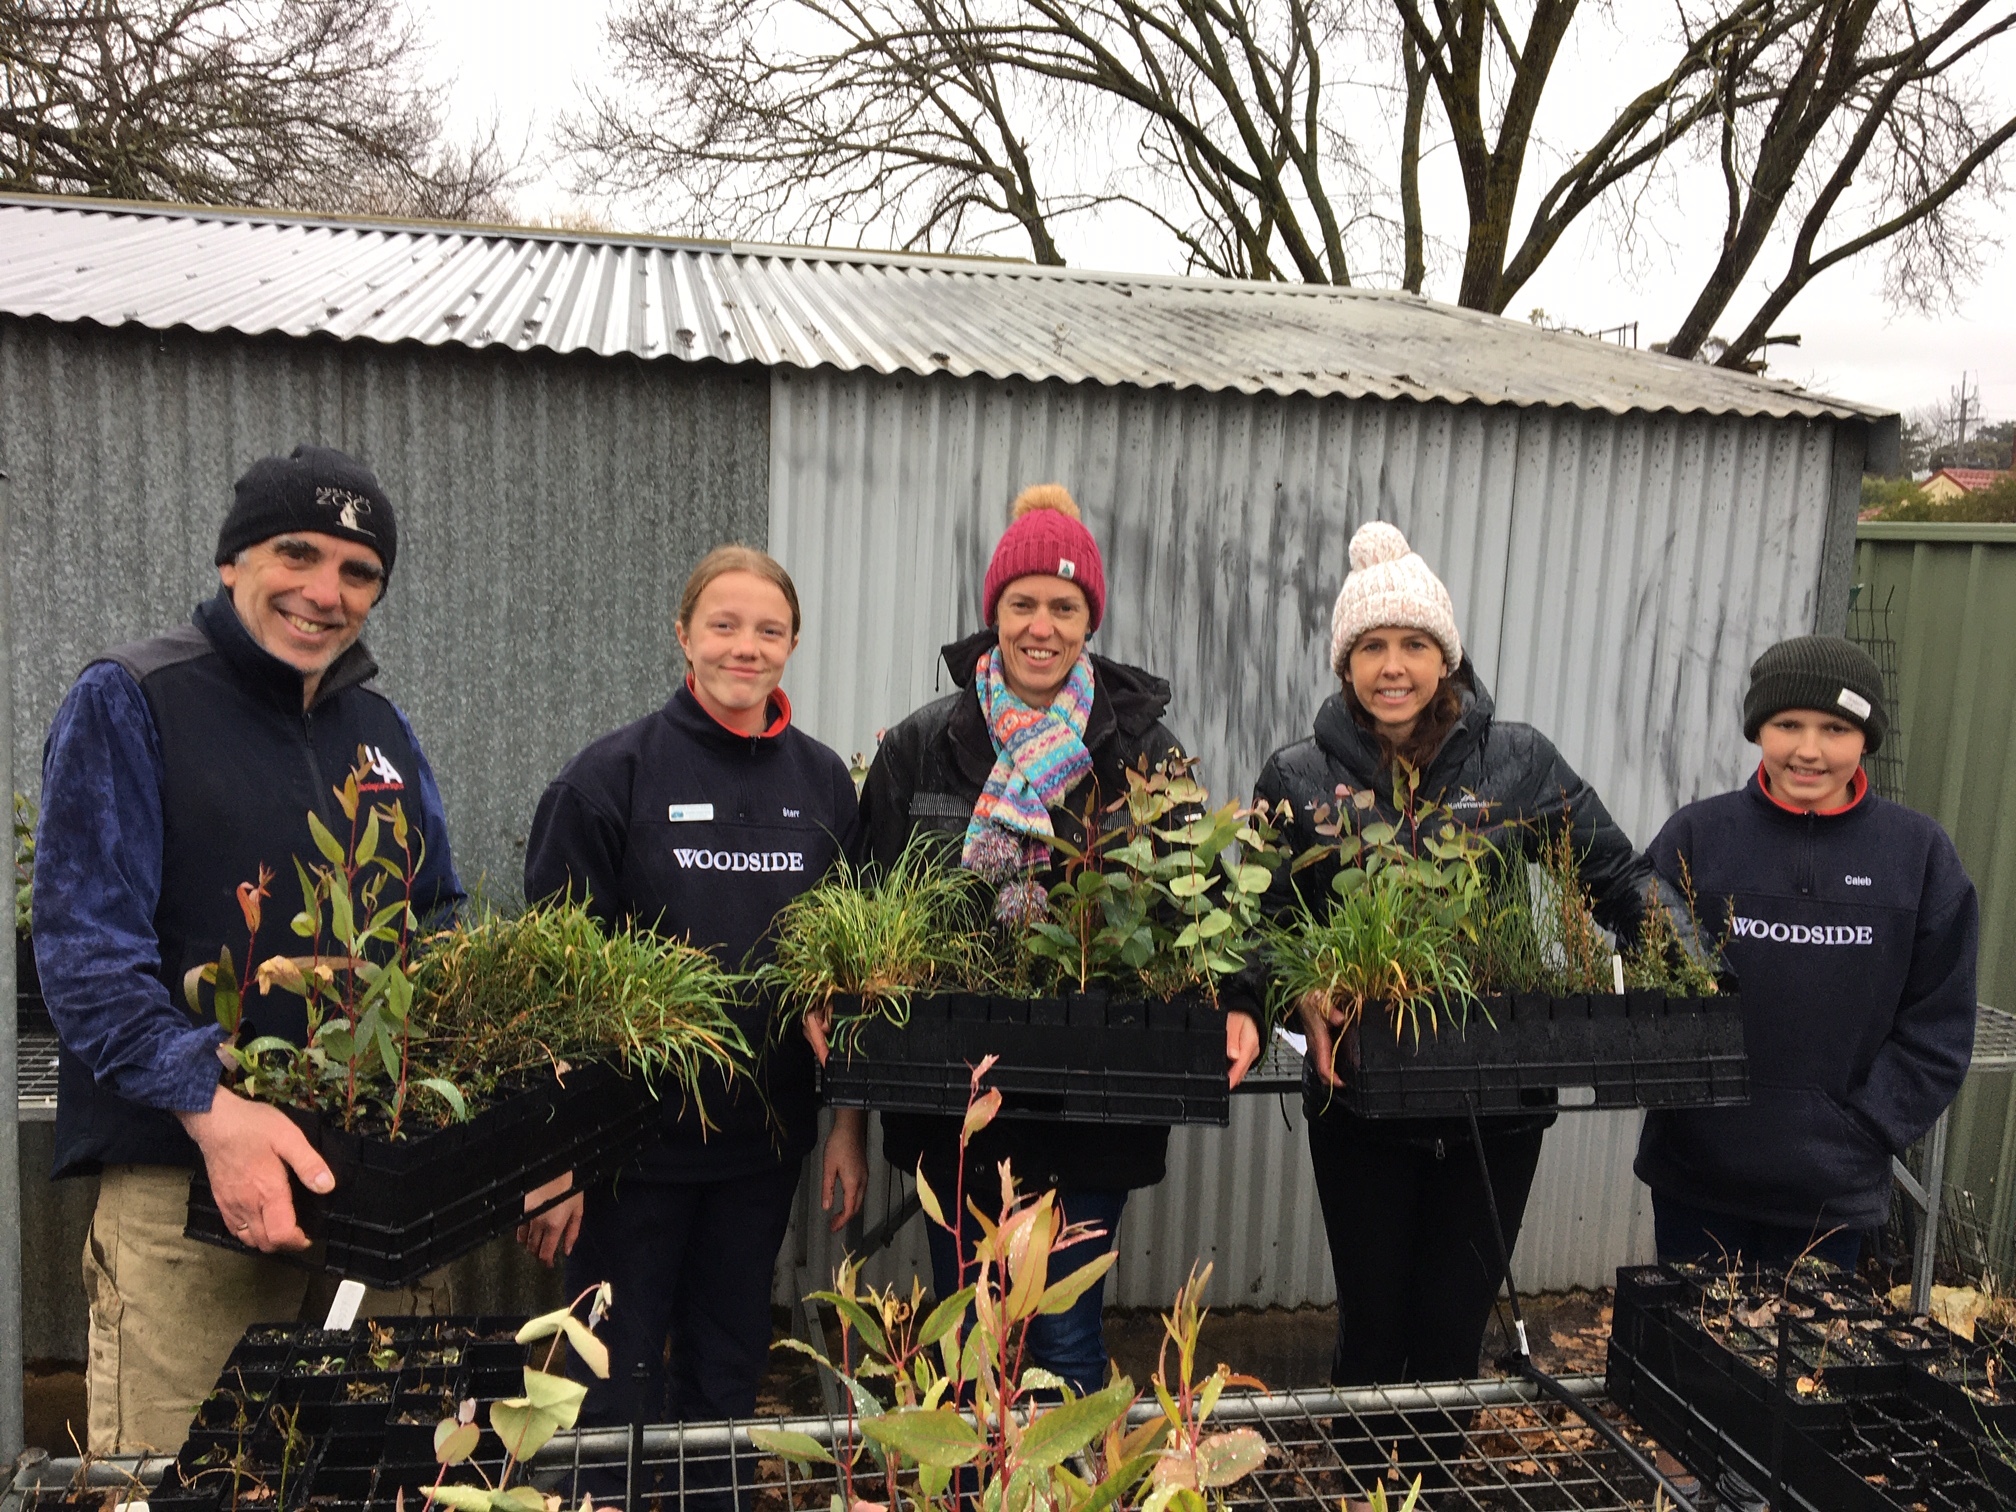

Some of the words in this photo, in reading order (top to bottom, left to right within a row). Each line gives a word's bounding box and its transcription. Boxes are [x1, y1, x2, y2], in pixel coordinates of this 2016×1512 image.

[316, 491, 372, 515] ZOO
[672, 847, 804, 872] WOODSIDE
[1844, 874, 1872, 886] Caleb
[1732, 916, 1873, 945] WOODSIDE
